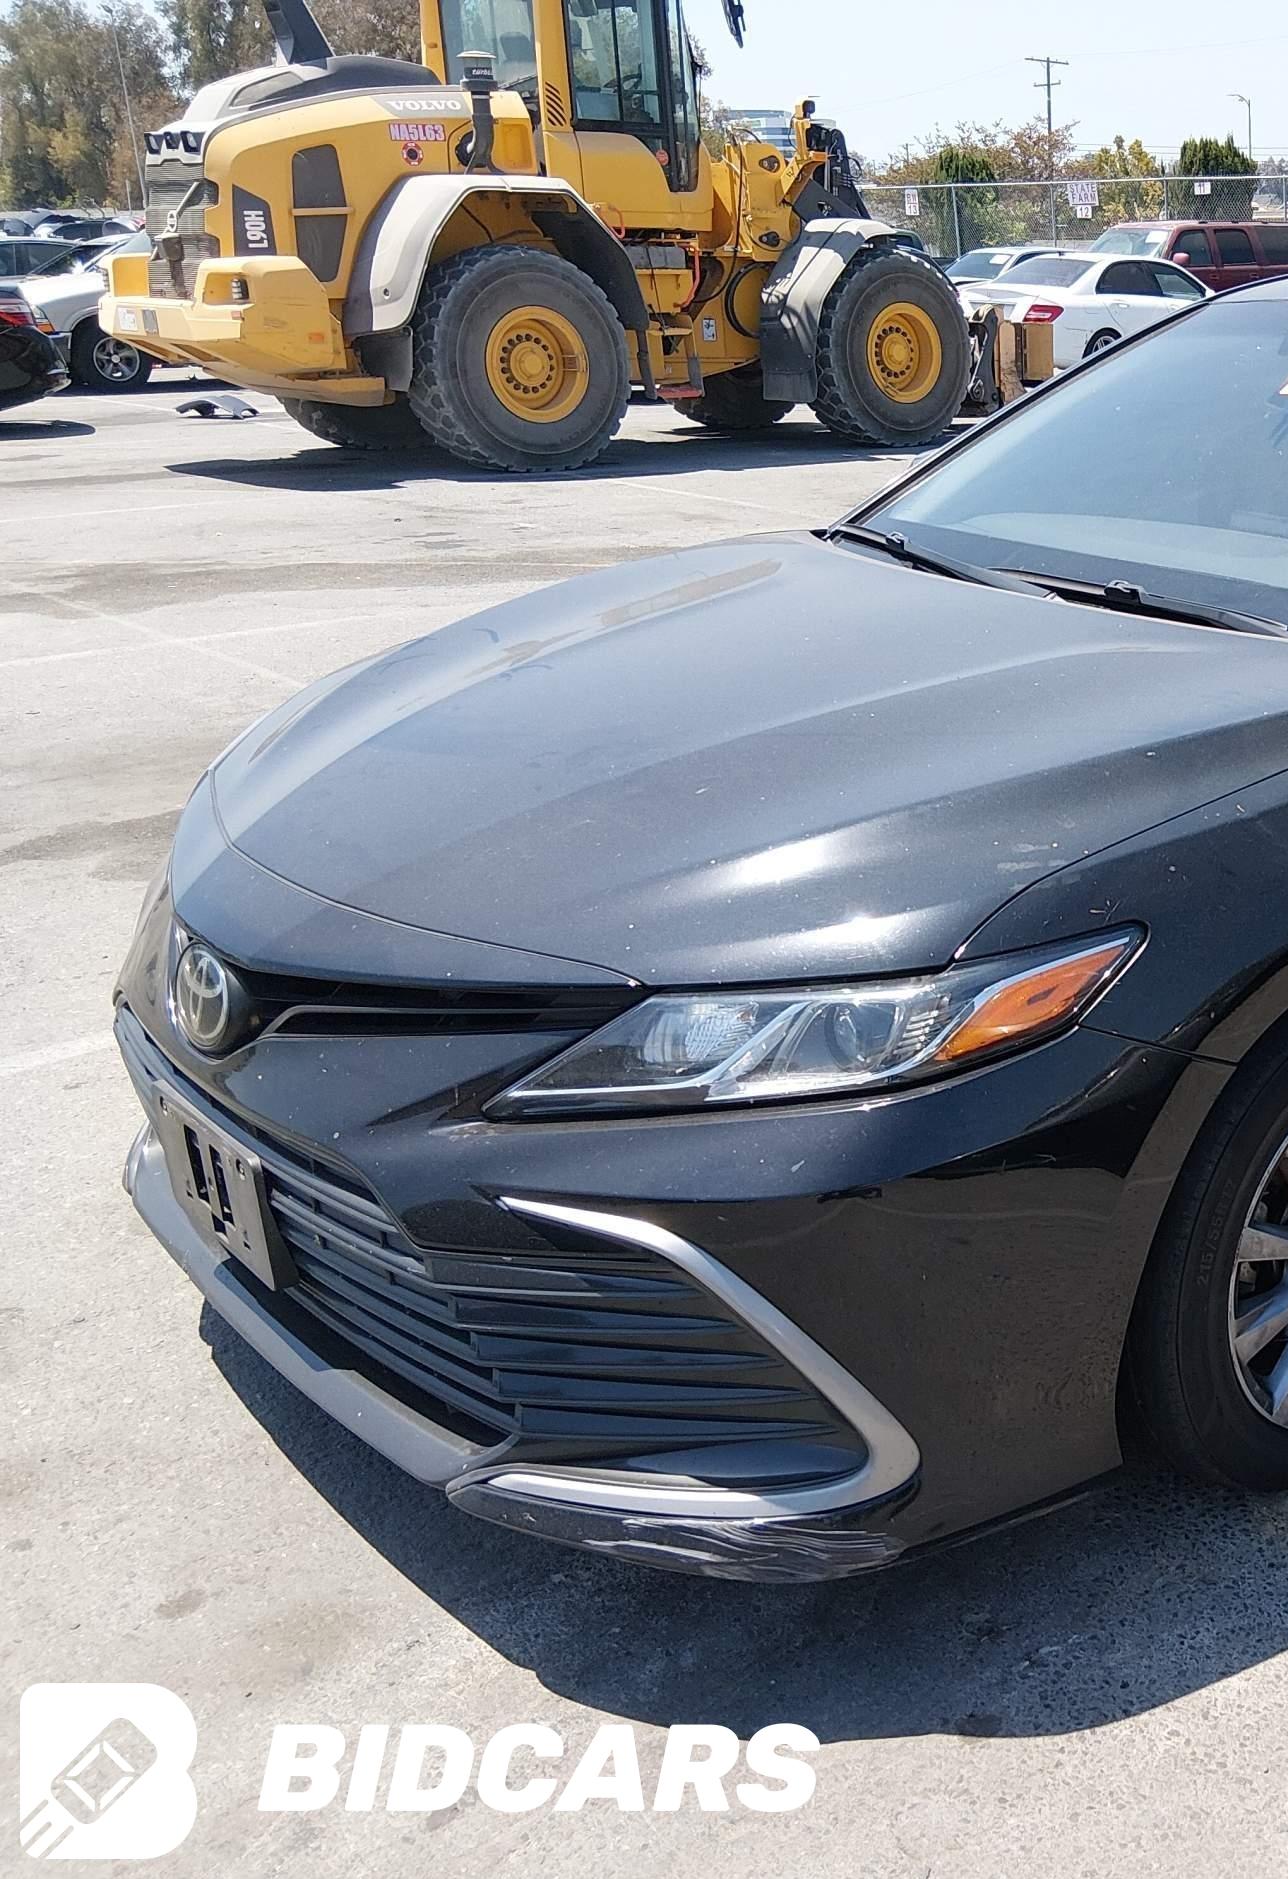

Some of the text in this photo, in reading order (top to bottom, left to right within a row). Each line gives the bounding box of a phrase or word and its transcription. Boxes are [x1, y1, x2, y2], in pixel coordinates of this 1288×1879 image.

[386, 99, 462, 112] VOLVO
[1069, 183, 1096, 193] STATE
[1071, 193, 1097, 202] FARM
[1079, 206, 1089, 217] 12
[243, 210, 269, 249] L90H
